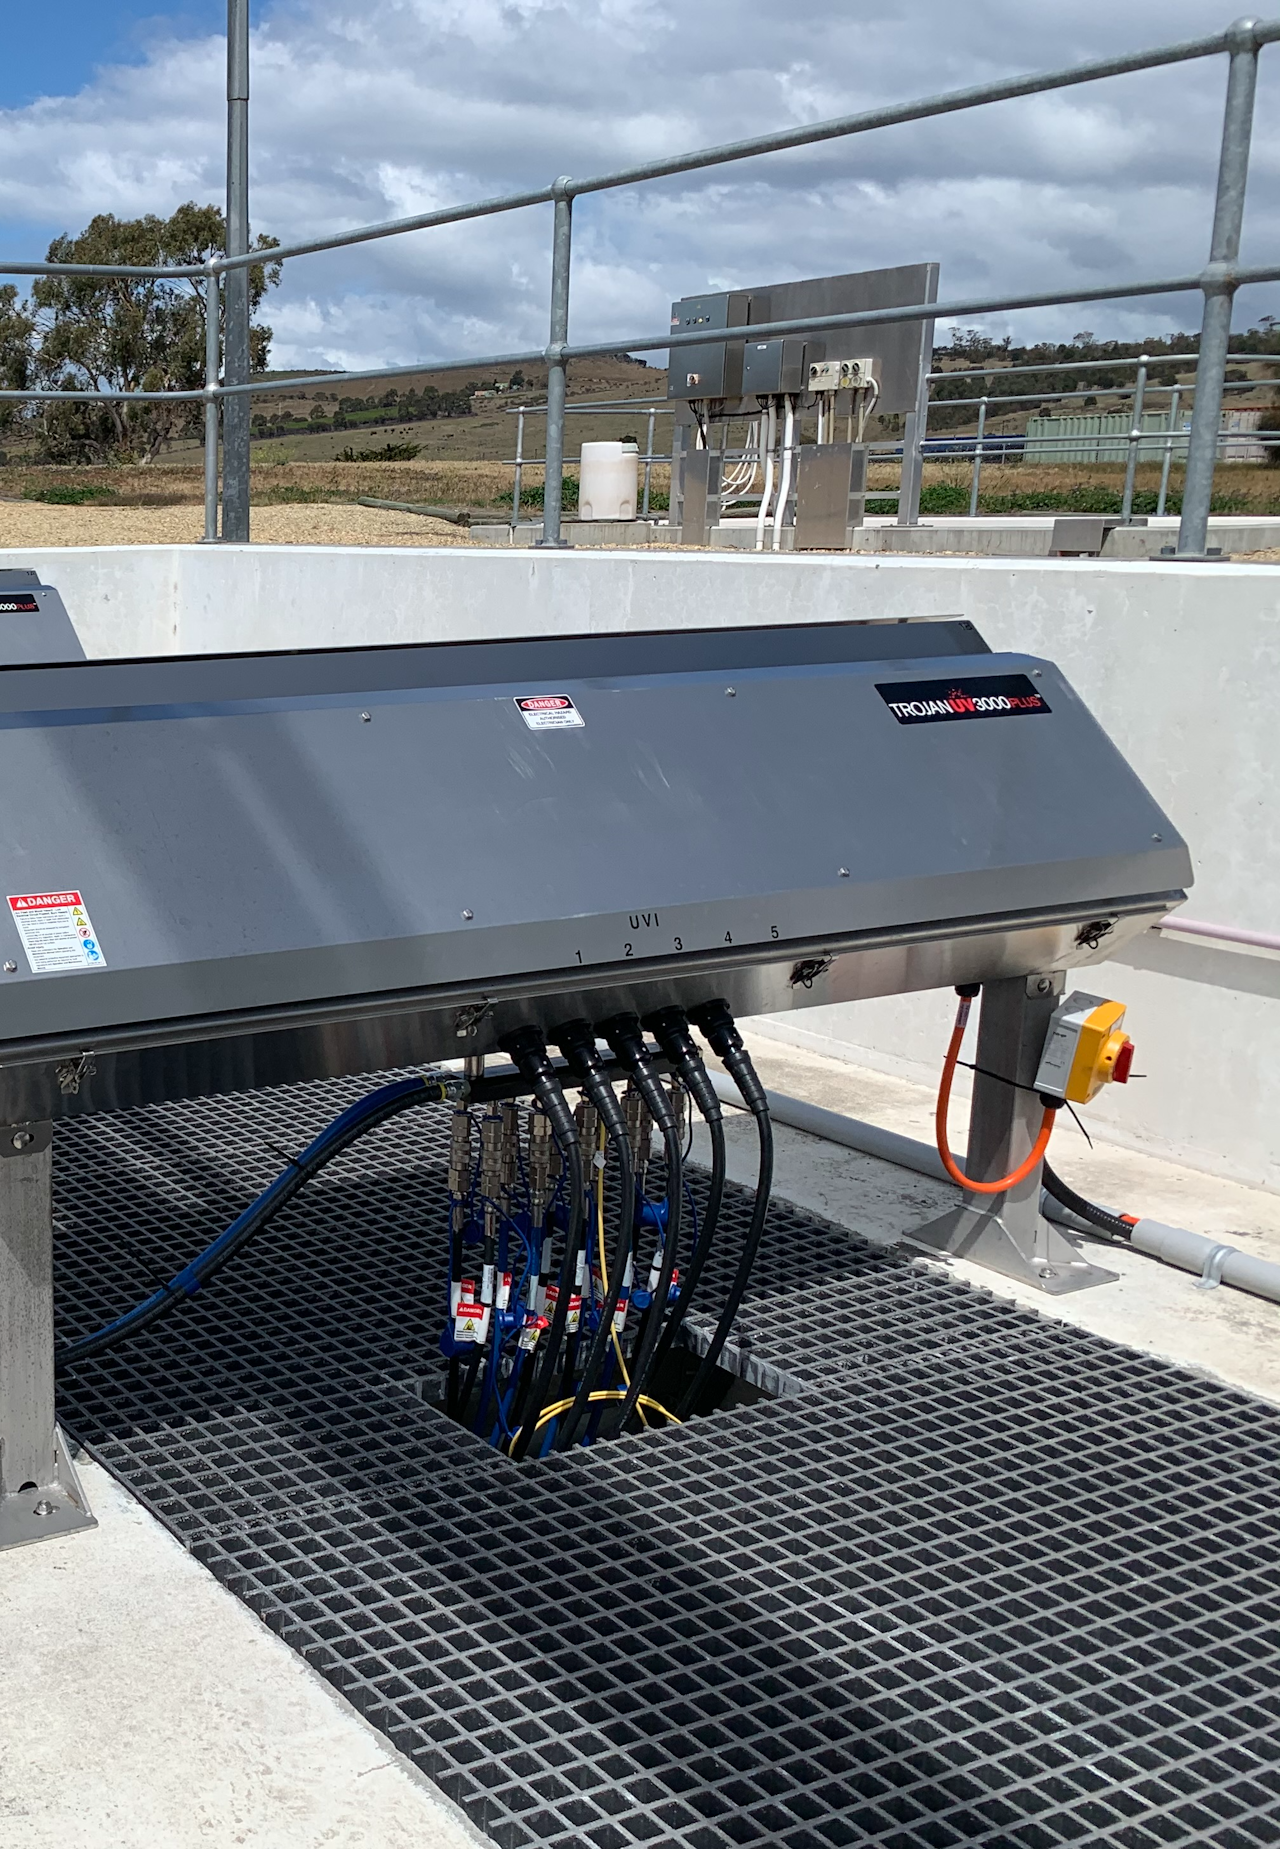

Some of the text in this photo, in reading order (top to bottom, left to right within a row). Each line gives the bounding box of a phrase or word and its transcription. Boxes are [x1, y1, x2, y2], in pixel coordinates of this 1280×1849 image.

[527, 699, 562, 709] DANGER
[26, 894, 76, 906] DANGER
[629, 913, 659, 930] UVI
[575, 925, 780, 964] 1 2 3 4 5
